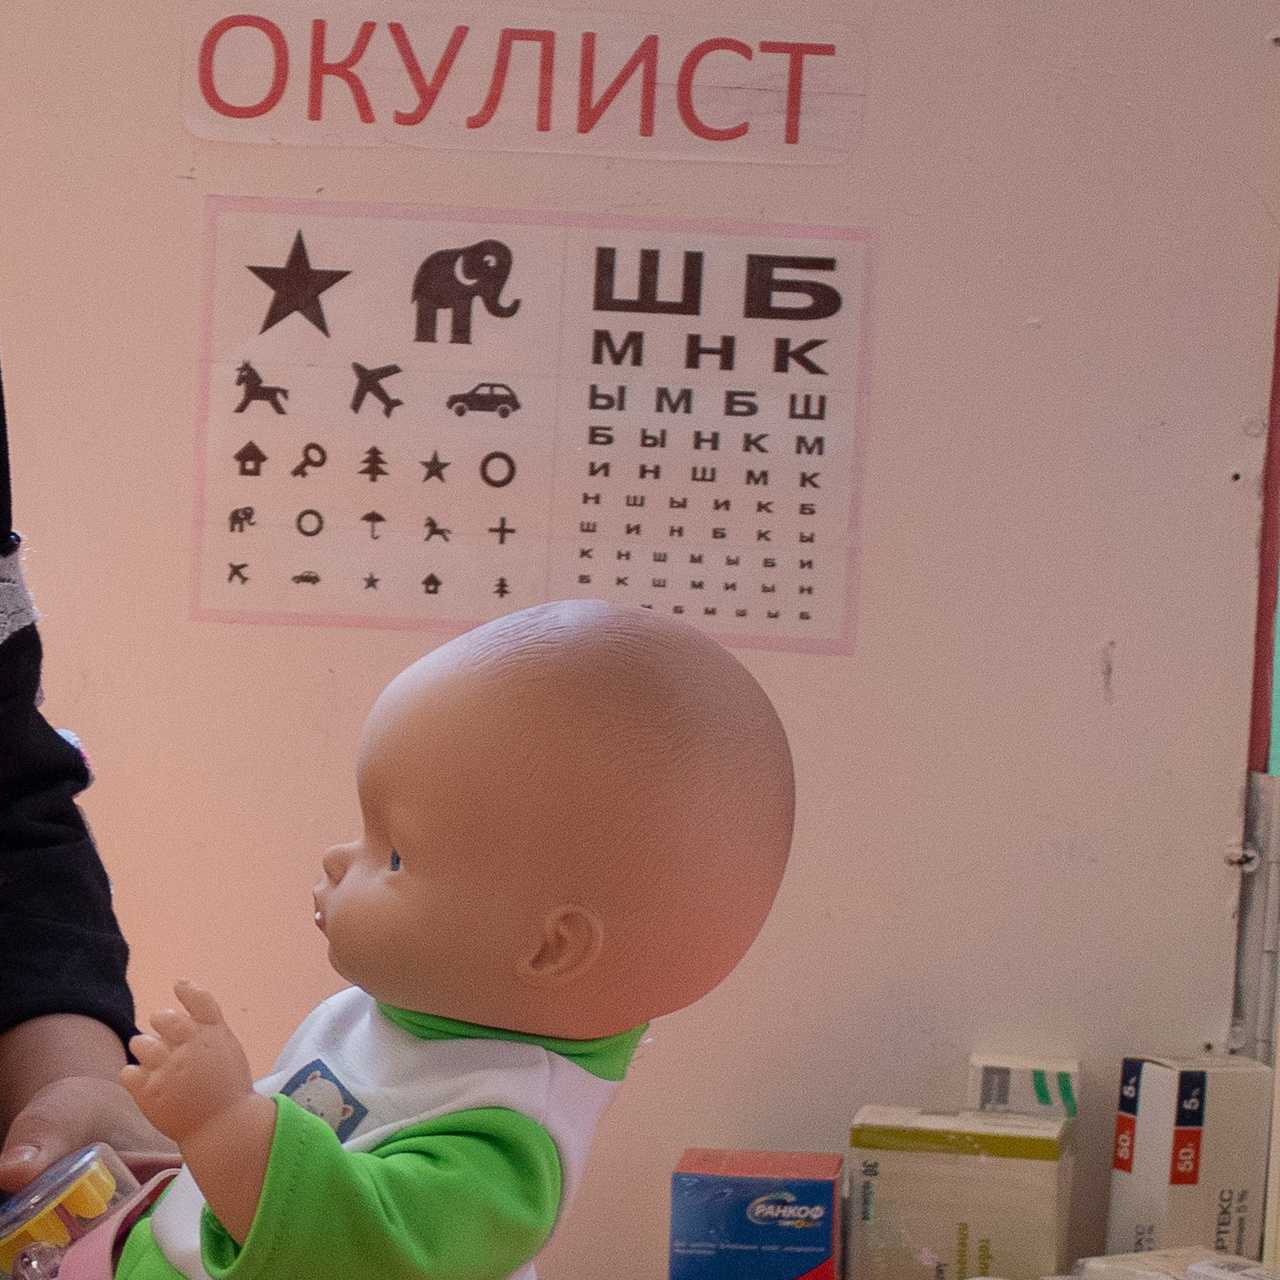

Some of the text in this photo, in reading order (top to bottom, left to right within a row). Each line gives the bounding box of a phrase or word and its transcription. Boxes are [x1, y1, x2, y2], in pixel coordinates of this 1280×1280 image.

[197, 14, 837, 145] ОКУЛИСТ
[593, 246, 843, 321] Ш Б
[1215, 1188, 1234, 1251] РТЕКС
